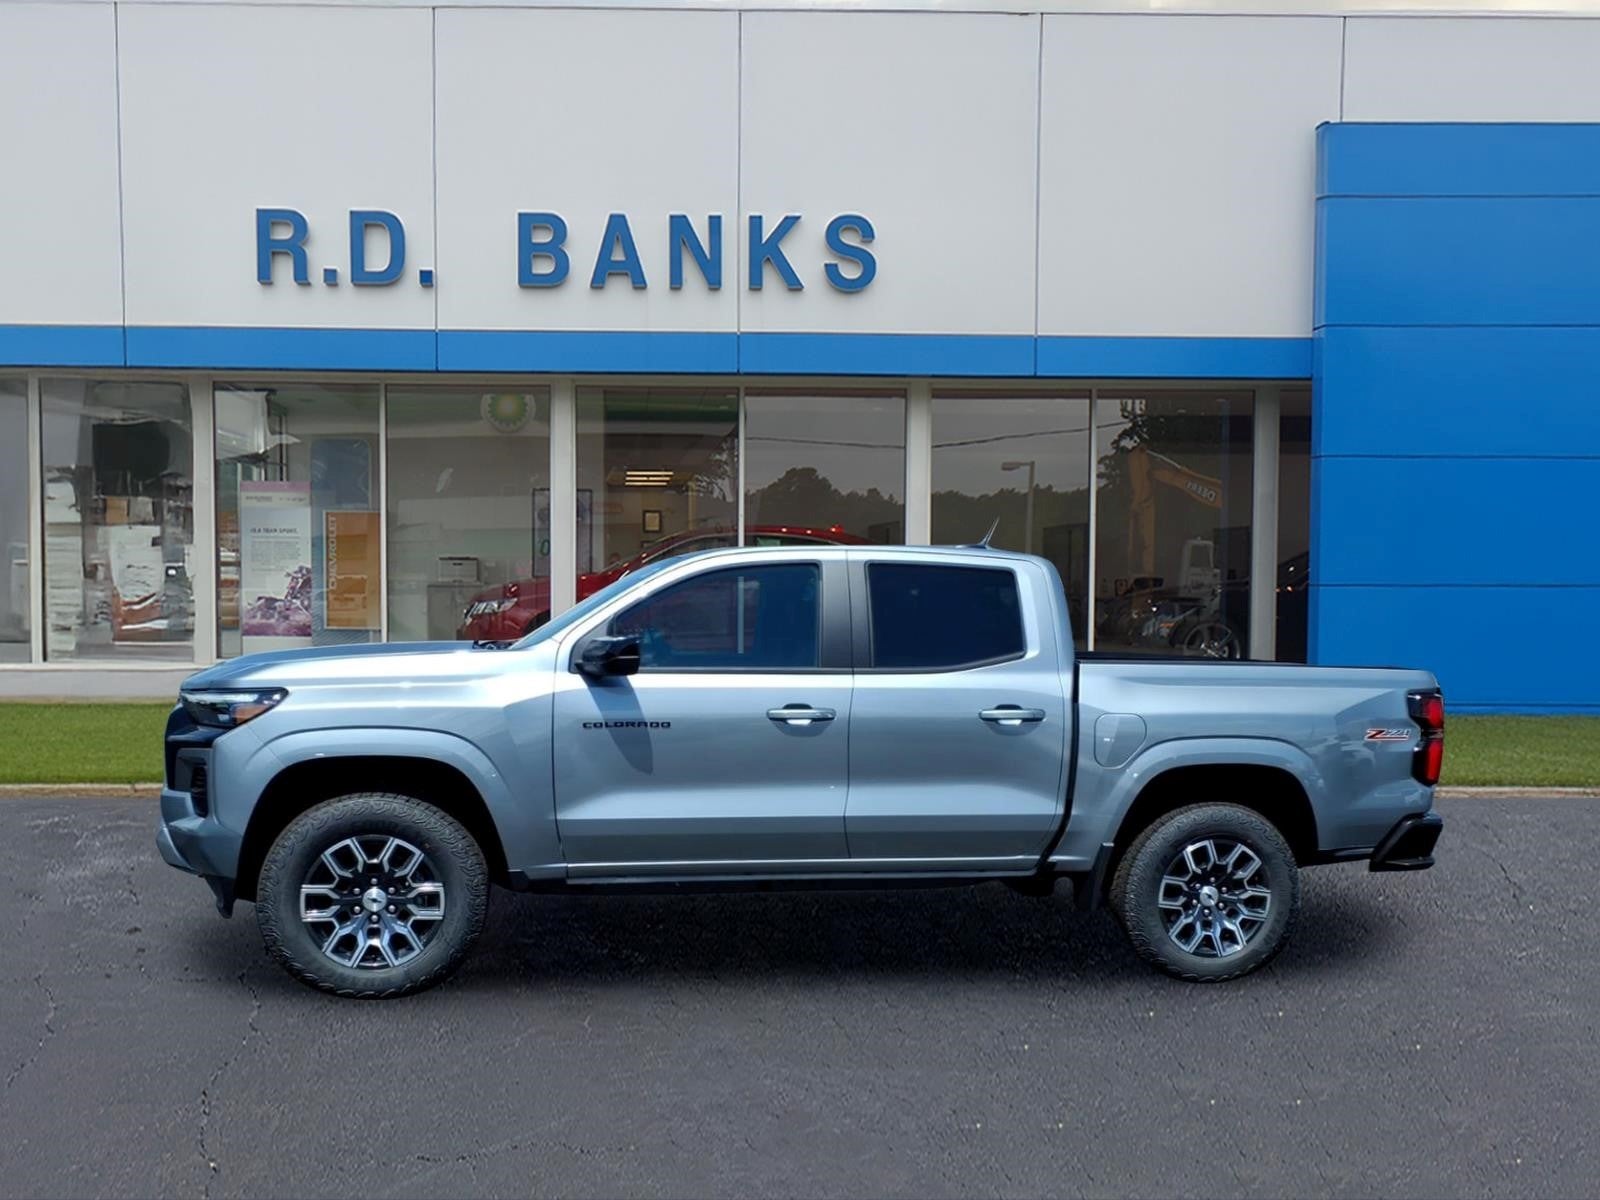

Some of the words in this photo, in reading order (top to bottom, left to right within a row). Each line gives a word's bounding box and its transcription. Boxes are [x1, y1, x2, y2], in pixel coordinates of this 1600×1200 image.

[256, 208, 434, 287] R.D.
[517, 212, 877, 293] BANKS
[582, 720, 671, 729] COLORADO
